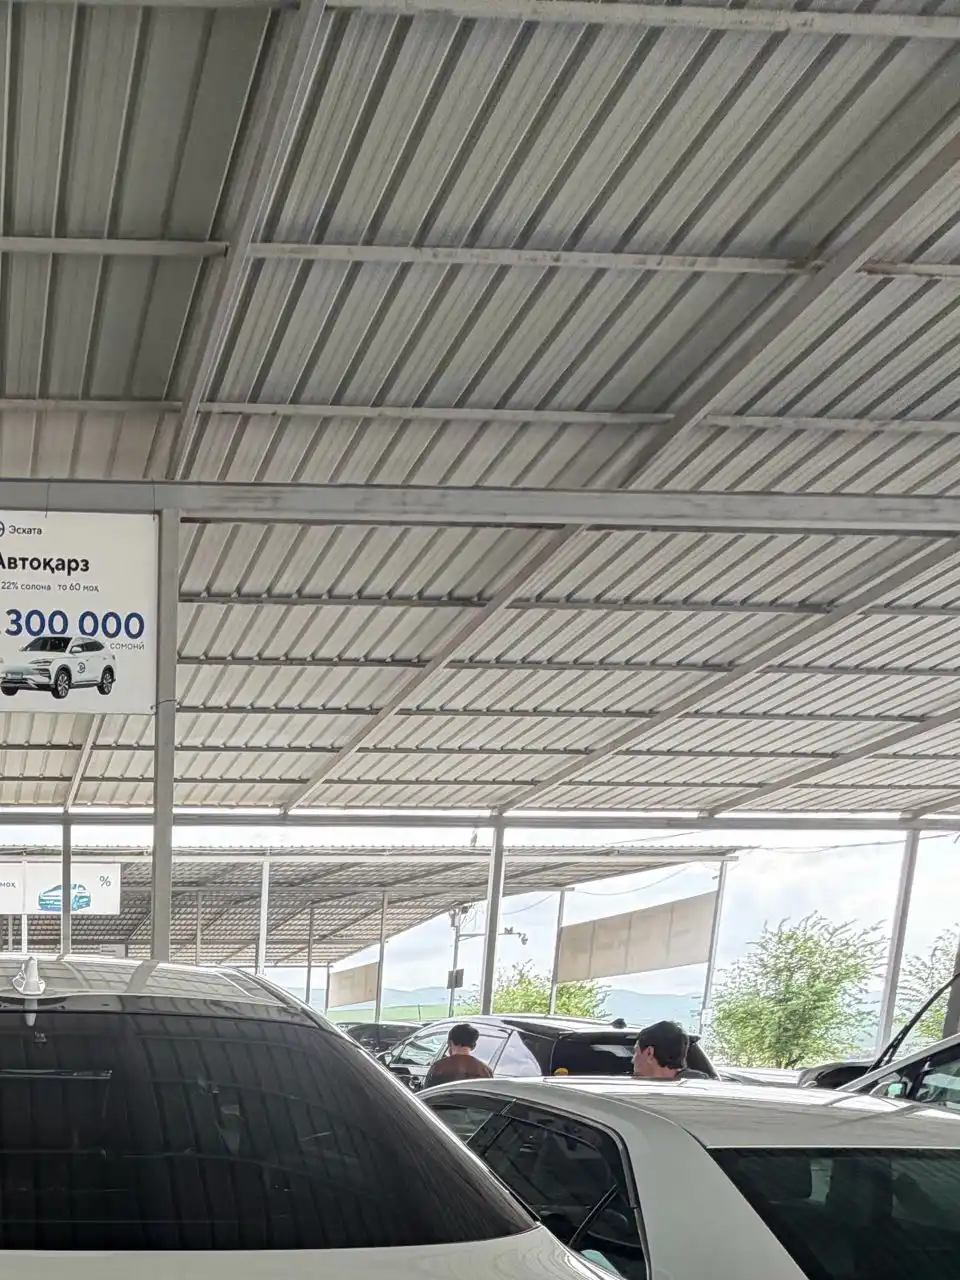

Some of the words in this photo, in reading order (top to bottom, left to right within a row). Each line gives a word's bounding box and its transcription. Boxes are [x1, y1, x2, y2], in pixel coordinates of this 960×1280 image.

[8, 525, 43, 536] Эсхата
[1, 581, 19, 591] 22%
[69, 582, 81, 592] 60
[4, 608, 69, 637] 300
[78, 610, 145, 640] 000
[99, 875, 112, 888] %
